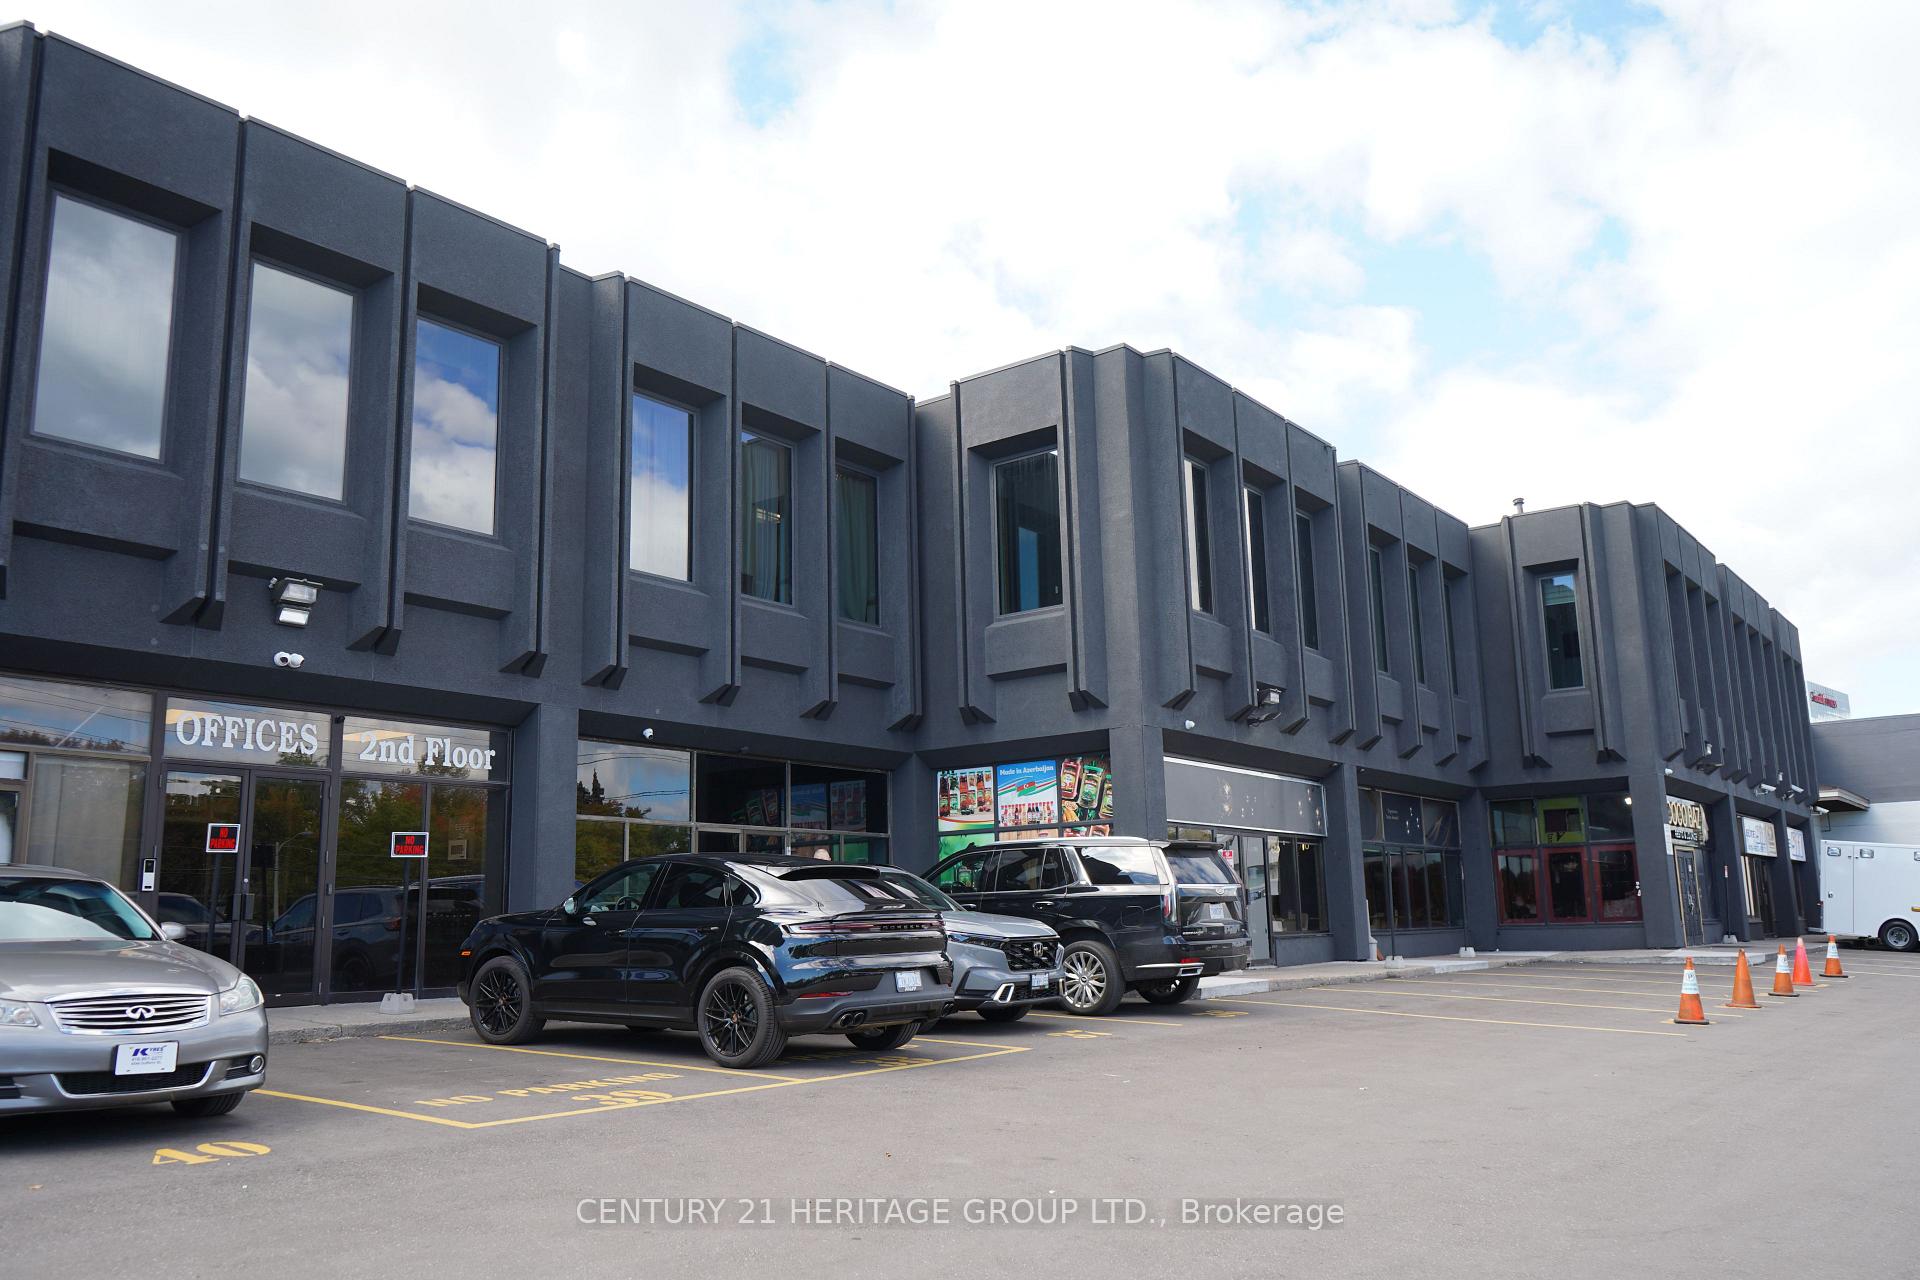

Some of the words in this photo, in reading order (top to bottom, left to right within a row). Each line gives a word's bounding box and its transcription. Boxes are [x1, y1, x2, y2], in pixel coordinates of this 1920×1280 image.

[176, 713, 318, 755] OFFICES
[359, 731, 415, 764] 2nd
[425, 737, 496, 770] Floor
[1000, 768, 1016, 776] Made
[1023, 764, 1054, 774] Azerbaijan
[219, 826, 229, 838] NO
[209, 838, 236, 849] PARKING
[405, 835, 415, 845] NO
[395, 845, 424, 855] PARKING
[414, 1094, 494, 1107] NO
[496, 1072, 685, 1097] PARKING
[570, 1089, 673, 1106] 39
[151, 1141, 272, 1165] 40
